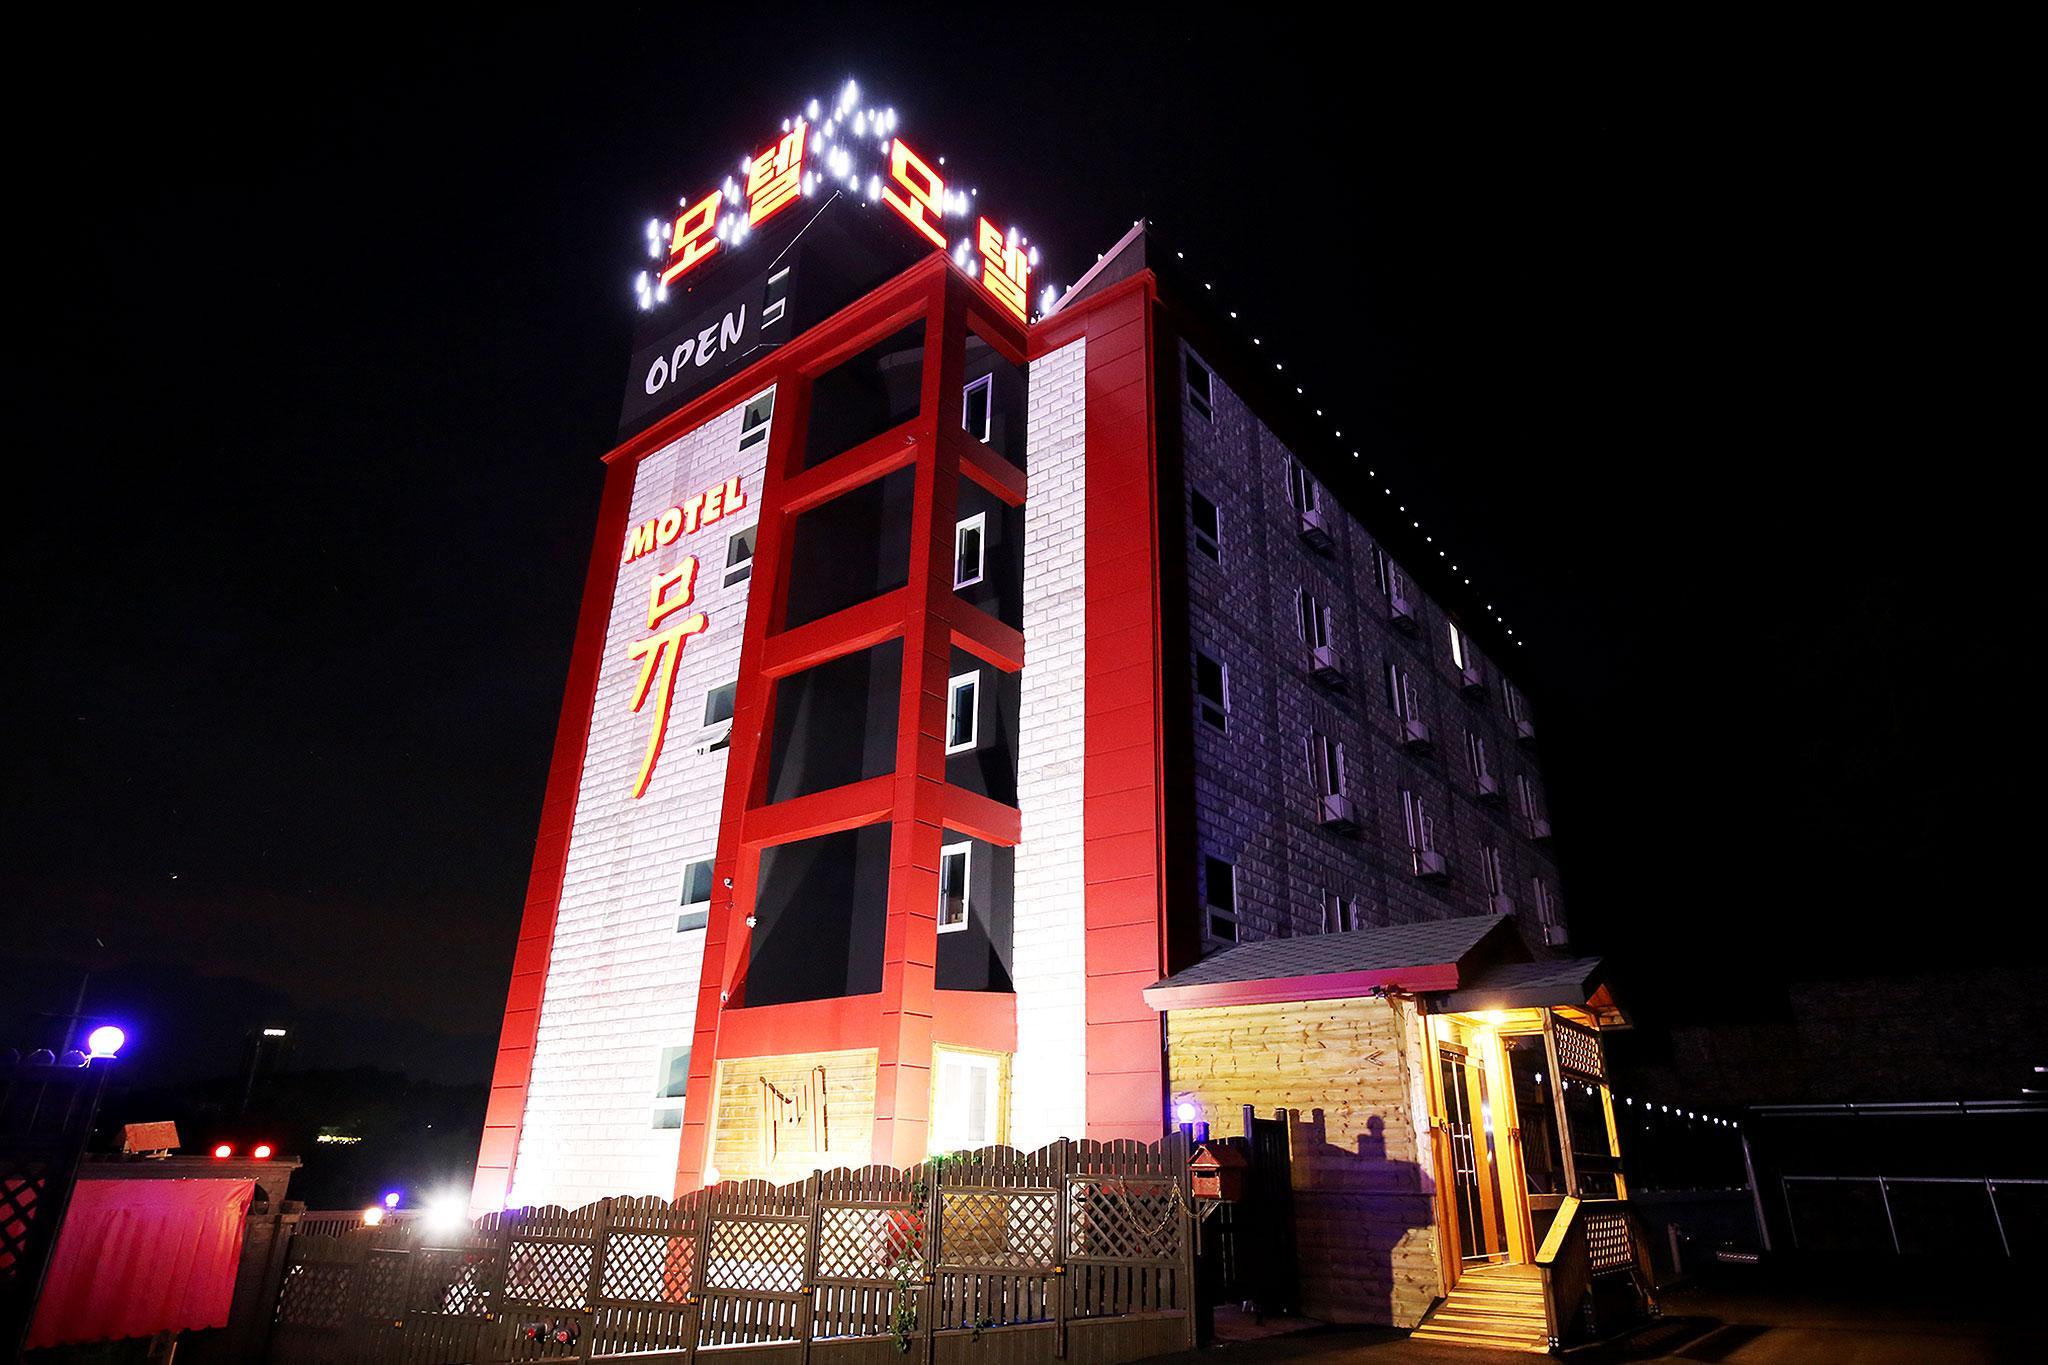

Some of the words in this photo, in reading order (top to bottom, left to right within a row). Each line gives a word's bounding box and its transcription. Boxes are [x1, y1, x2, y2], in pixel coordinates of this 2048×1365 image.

[659, 121, 807, 287] 모텔
[881, 137, 1029, 324] 모텔
[645, 303, 746, 395] OPEN
[623, 476, 747, 563] MOTEL
[627, 555, 709, 799] 뮤
